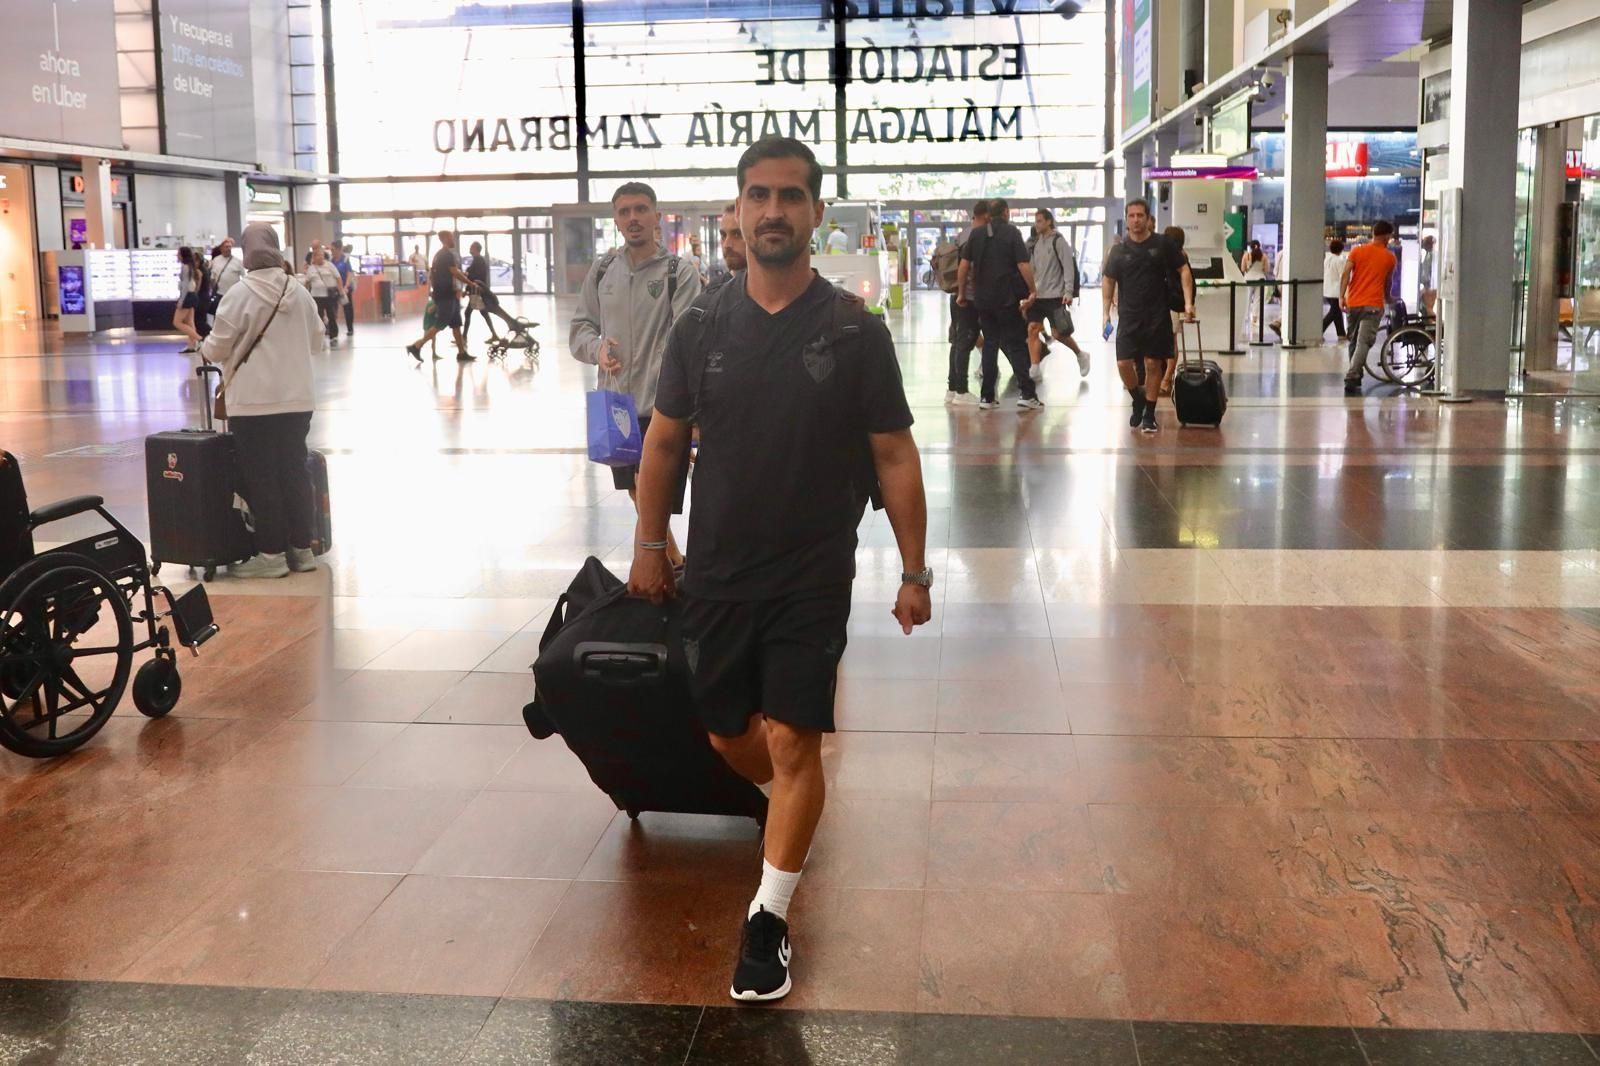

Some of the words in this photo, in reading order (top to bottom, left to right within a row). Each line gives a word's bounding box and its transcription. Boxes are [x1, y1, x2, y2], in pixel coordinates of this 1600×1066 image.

[169, 14, 178, 33] Y
[179, 21, 224, 46] recupera
[224, 32, 234, 49] el
[39, 50, 80, 77] ahora
[31, 84, 51, 104] en
[52, 82, 87, 109] Uber
[173, 73, 187, 93] de
[188, 76, 214, 98] Uber
